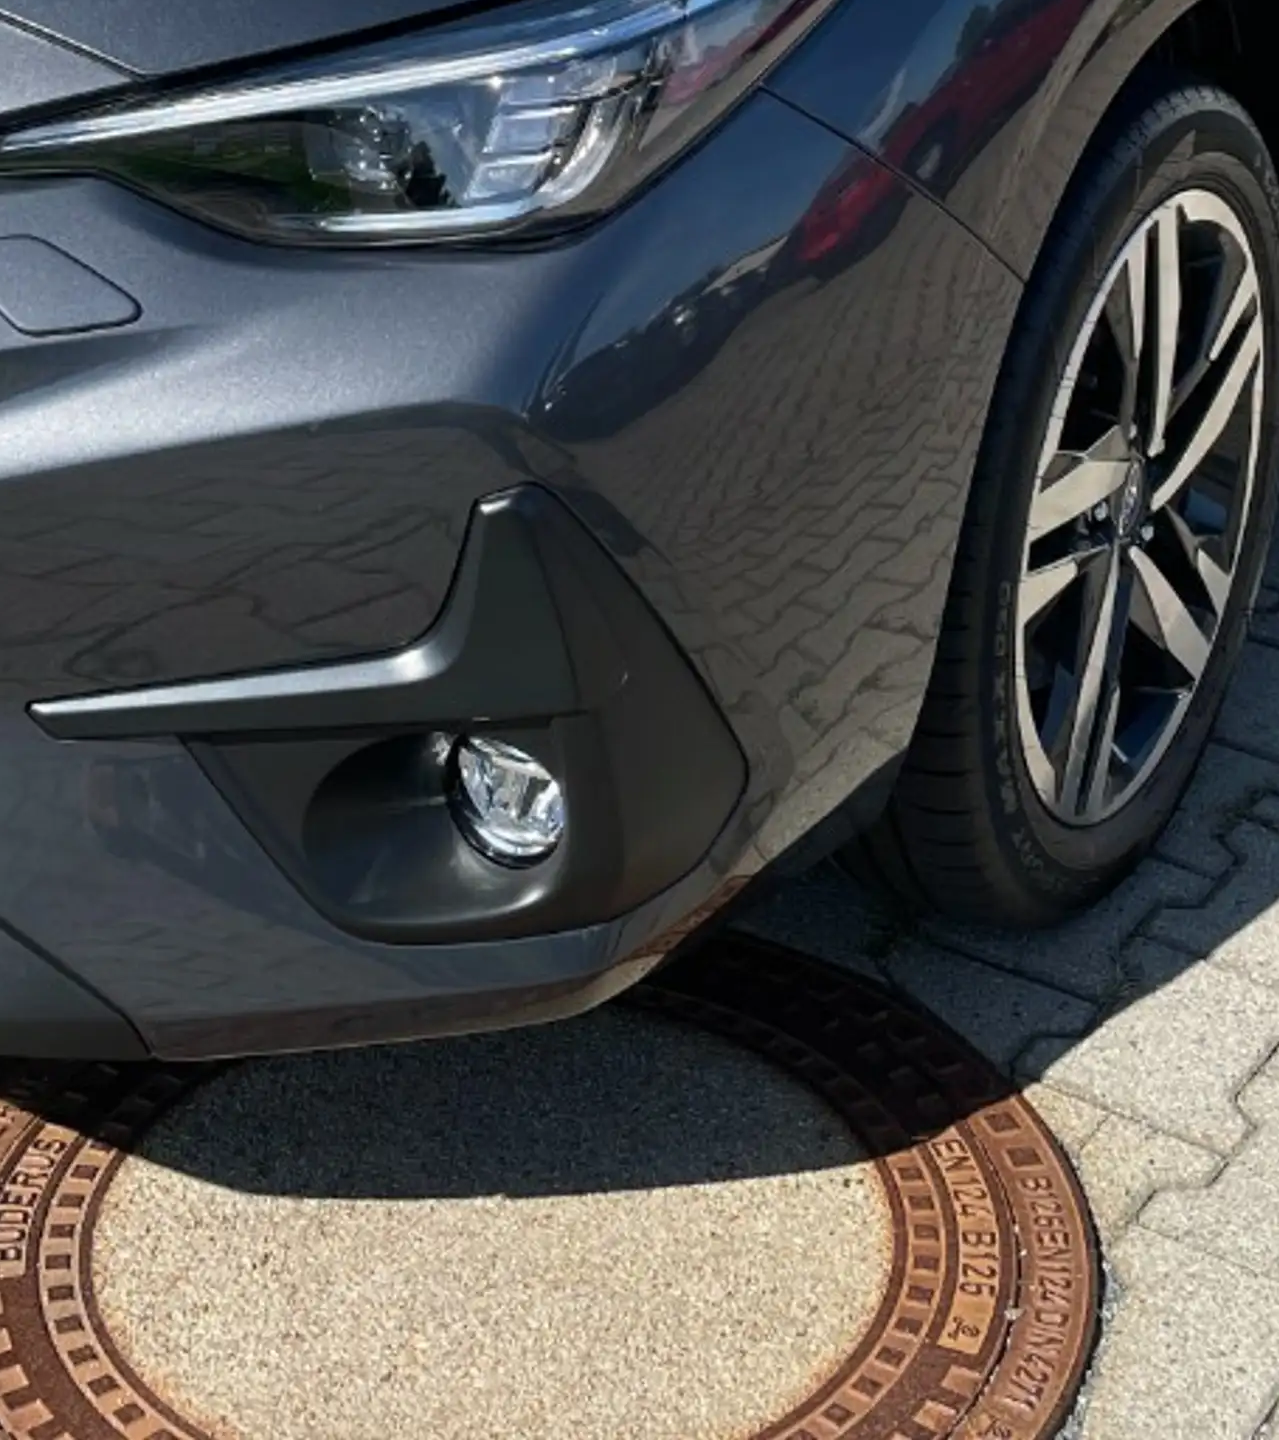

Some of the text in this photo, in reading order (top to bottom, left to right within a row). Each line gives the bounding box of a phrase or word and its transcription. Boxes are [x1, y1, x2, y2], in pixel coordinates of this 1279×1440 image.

[931, 1137, 970, 1172] EN
[954, 1172, 989, 1218] 124
[959, 1229, 998, 1298] B125
